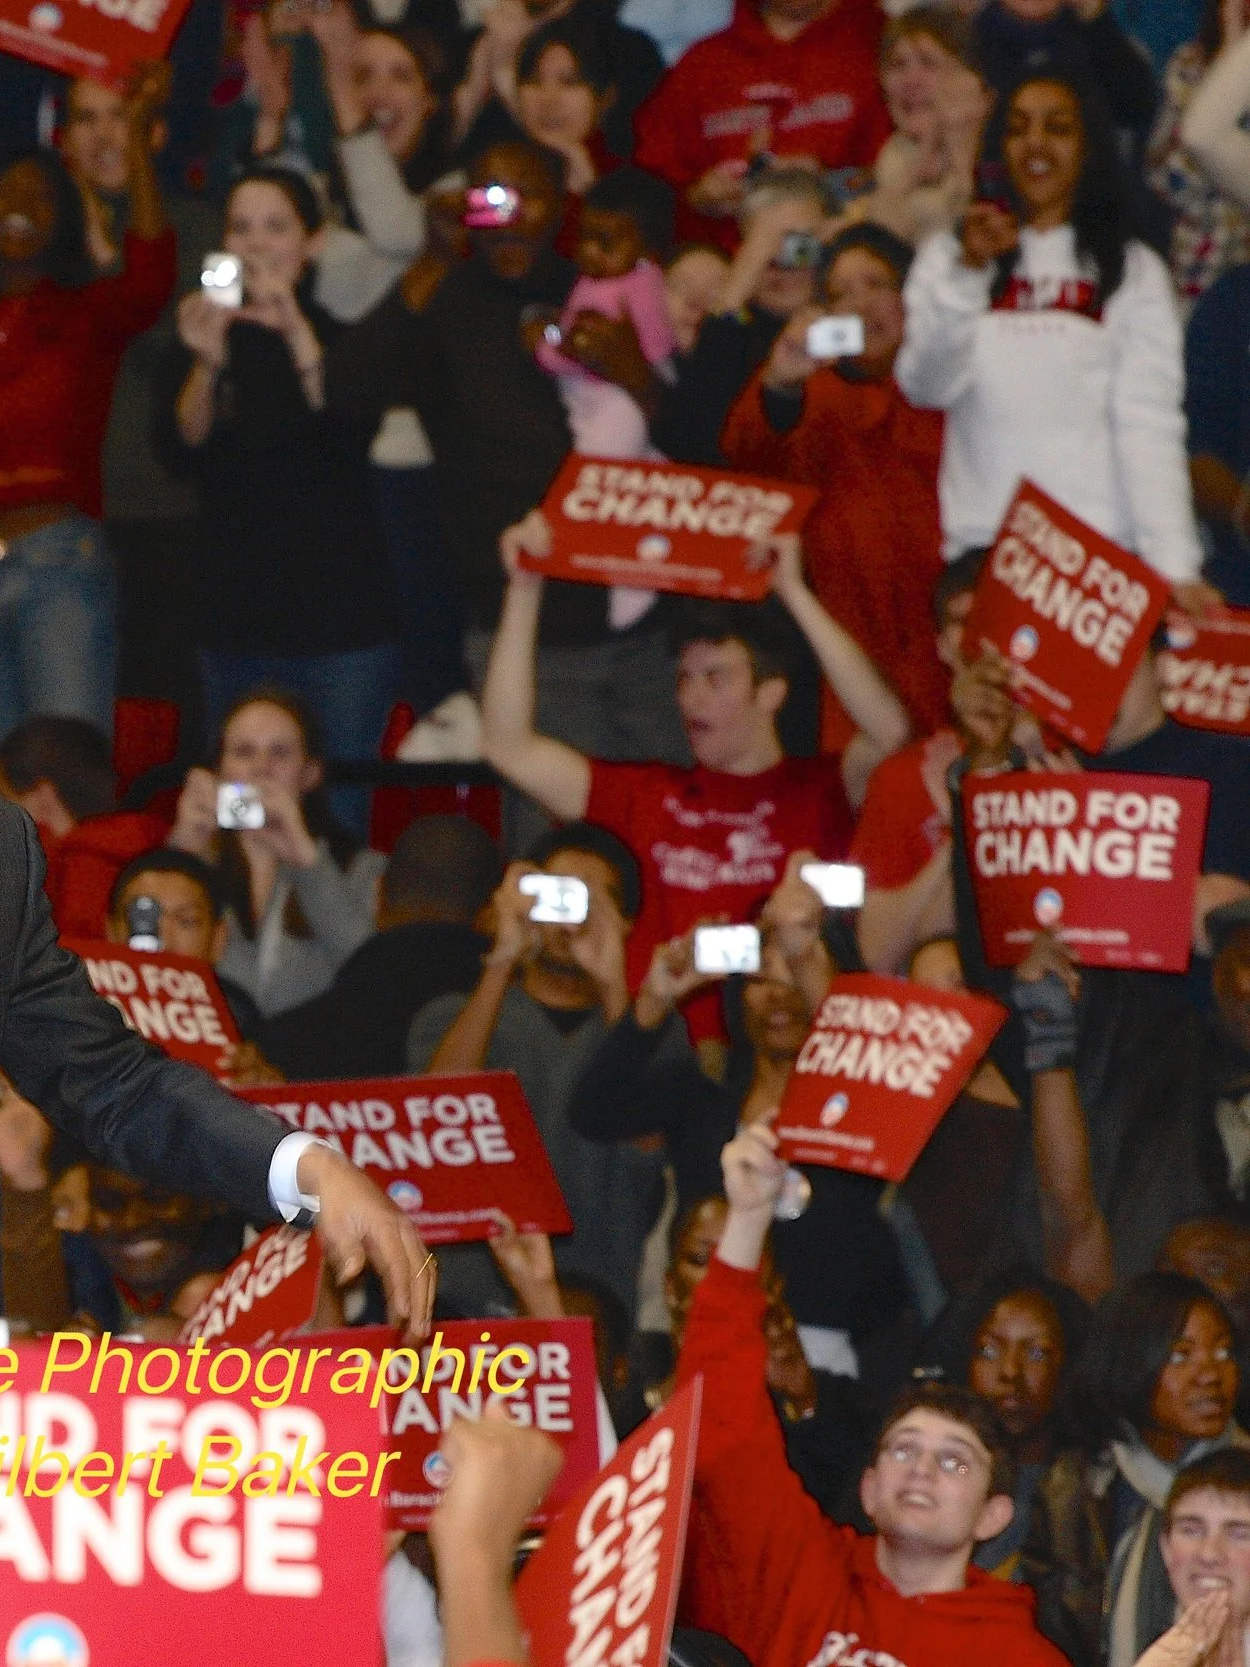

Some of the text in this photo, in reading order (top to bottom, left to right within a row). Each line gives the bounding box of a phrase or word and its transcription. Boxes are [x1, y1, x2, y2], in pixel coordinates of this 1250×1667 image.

[992, 535, 1134, 669] CHANGE
[1080, 556, 1150, 627] FOR
[972, 788, 1182, 833] STAND FOR
[974, 828, 1176, 881] CHANGE
[139, 962, 213, 1004] FOR
[899, 1002, 975, 1056] FOR
[796, 1030, 953, 1099] CHANGE
[273, 1092, 500, 1132] TAND FOR
[323, 1123, 517, 1170] ANGE
[468, 1341, 572, 1381] FOR
[380, 1382, 575, 1436] ANGE
[120, 1394, 327, 1487] FOR
[613, 1427, 676, 1628] STAND
